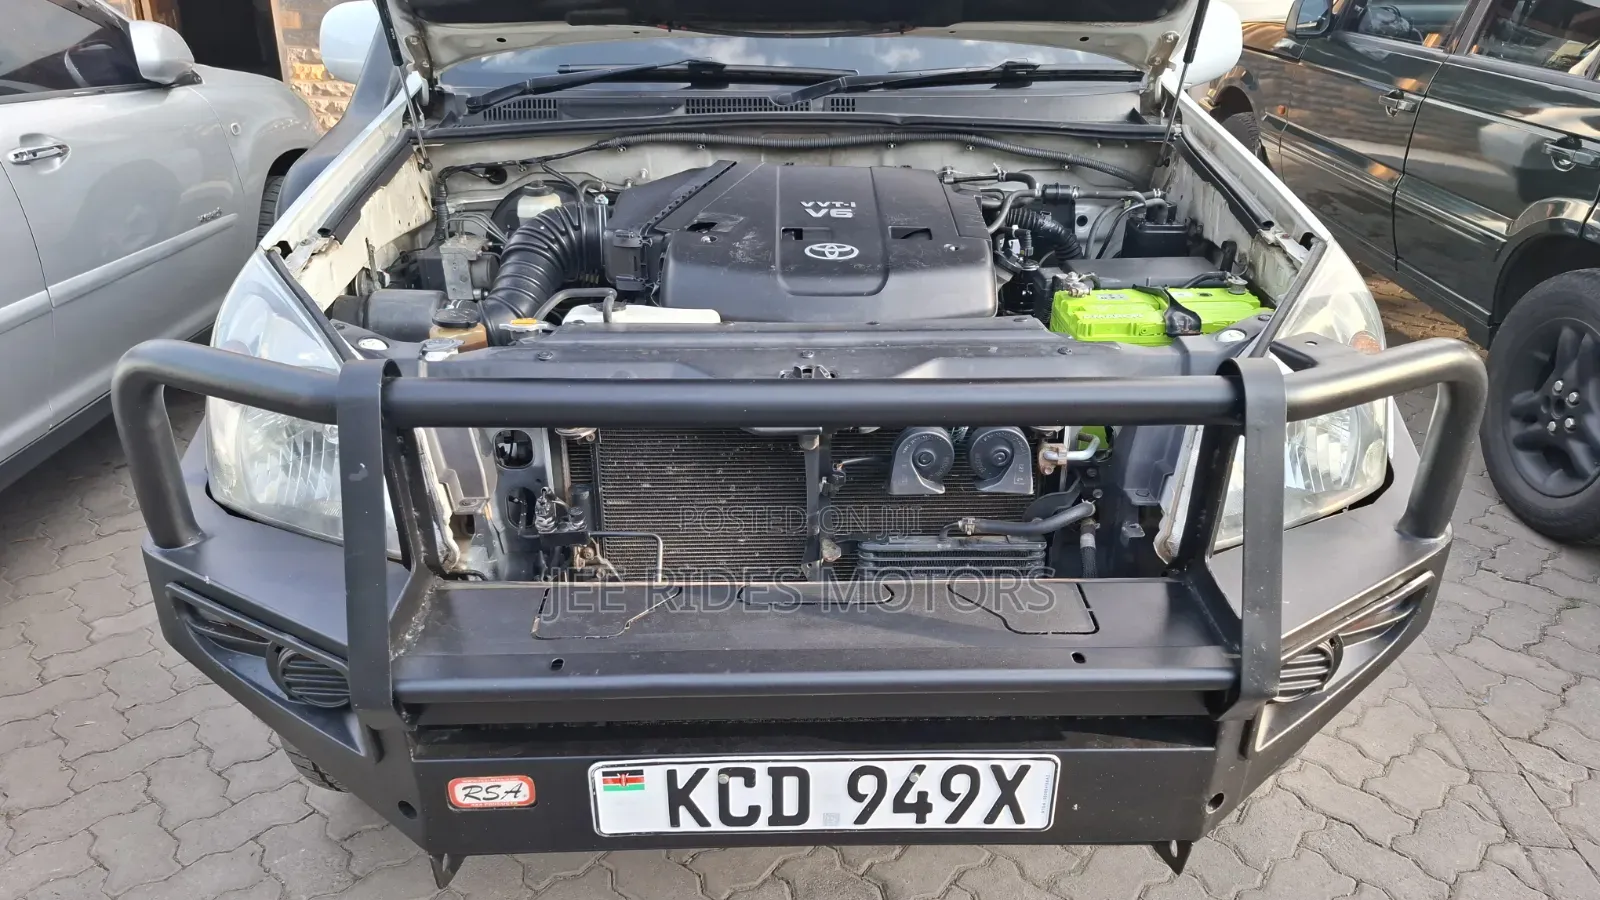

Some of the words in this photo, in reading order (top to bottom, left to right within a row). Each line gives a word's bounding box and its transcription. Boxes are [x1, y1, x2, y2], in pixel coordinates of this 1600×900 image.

[804, 208, 854, 218] V6
[461, 782, 523, 802] RSA
[666, 766, 810, 828] KCD
[846, 764, 1031, 826] 949X
